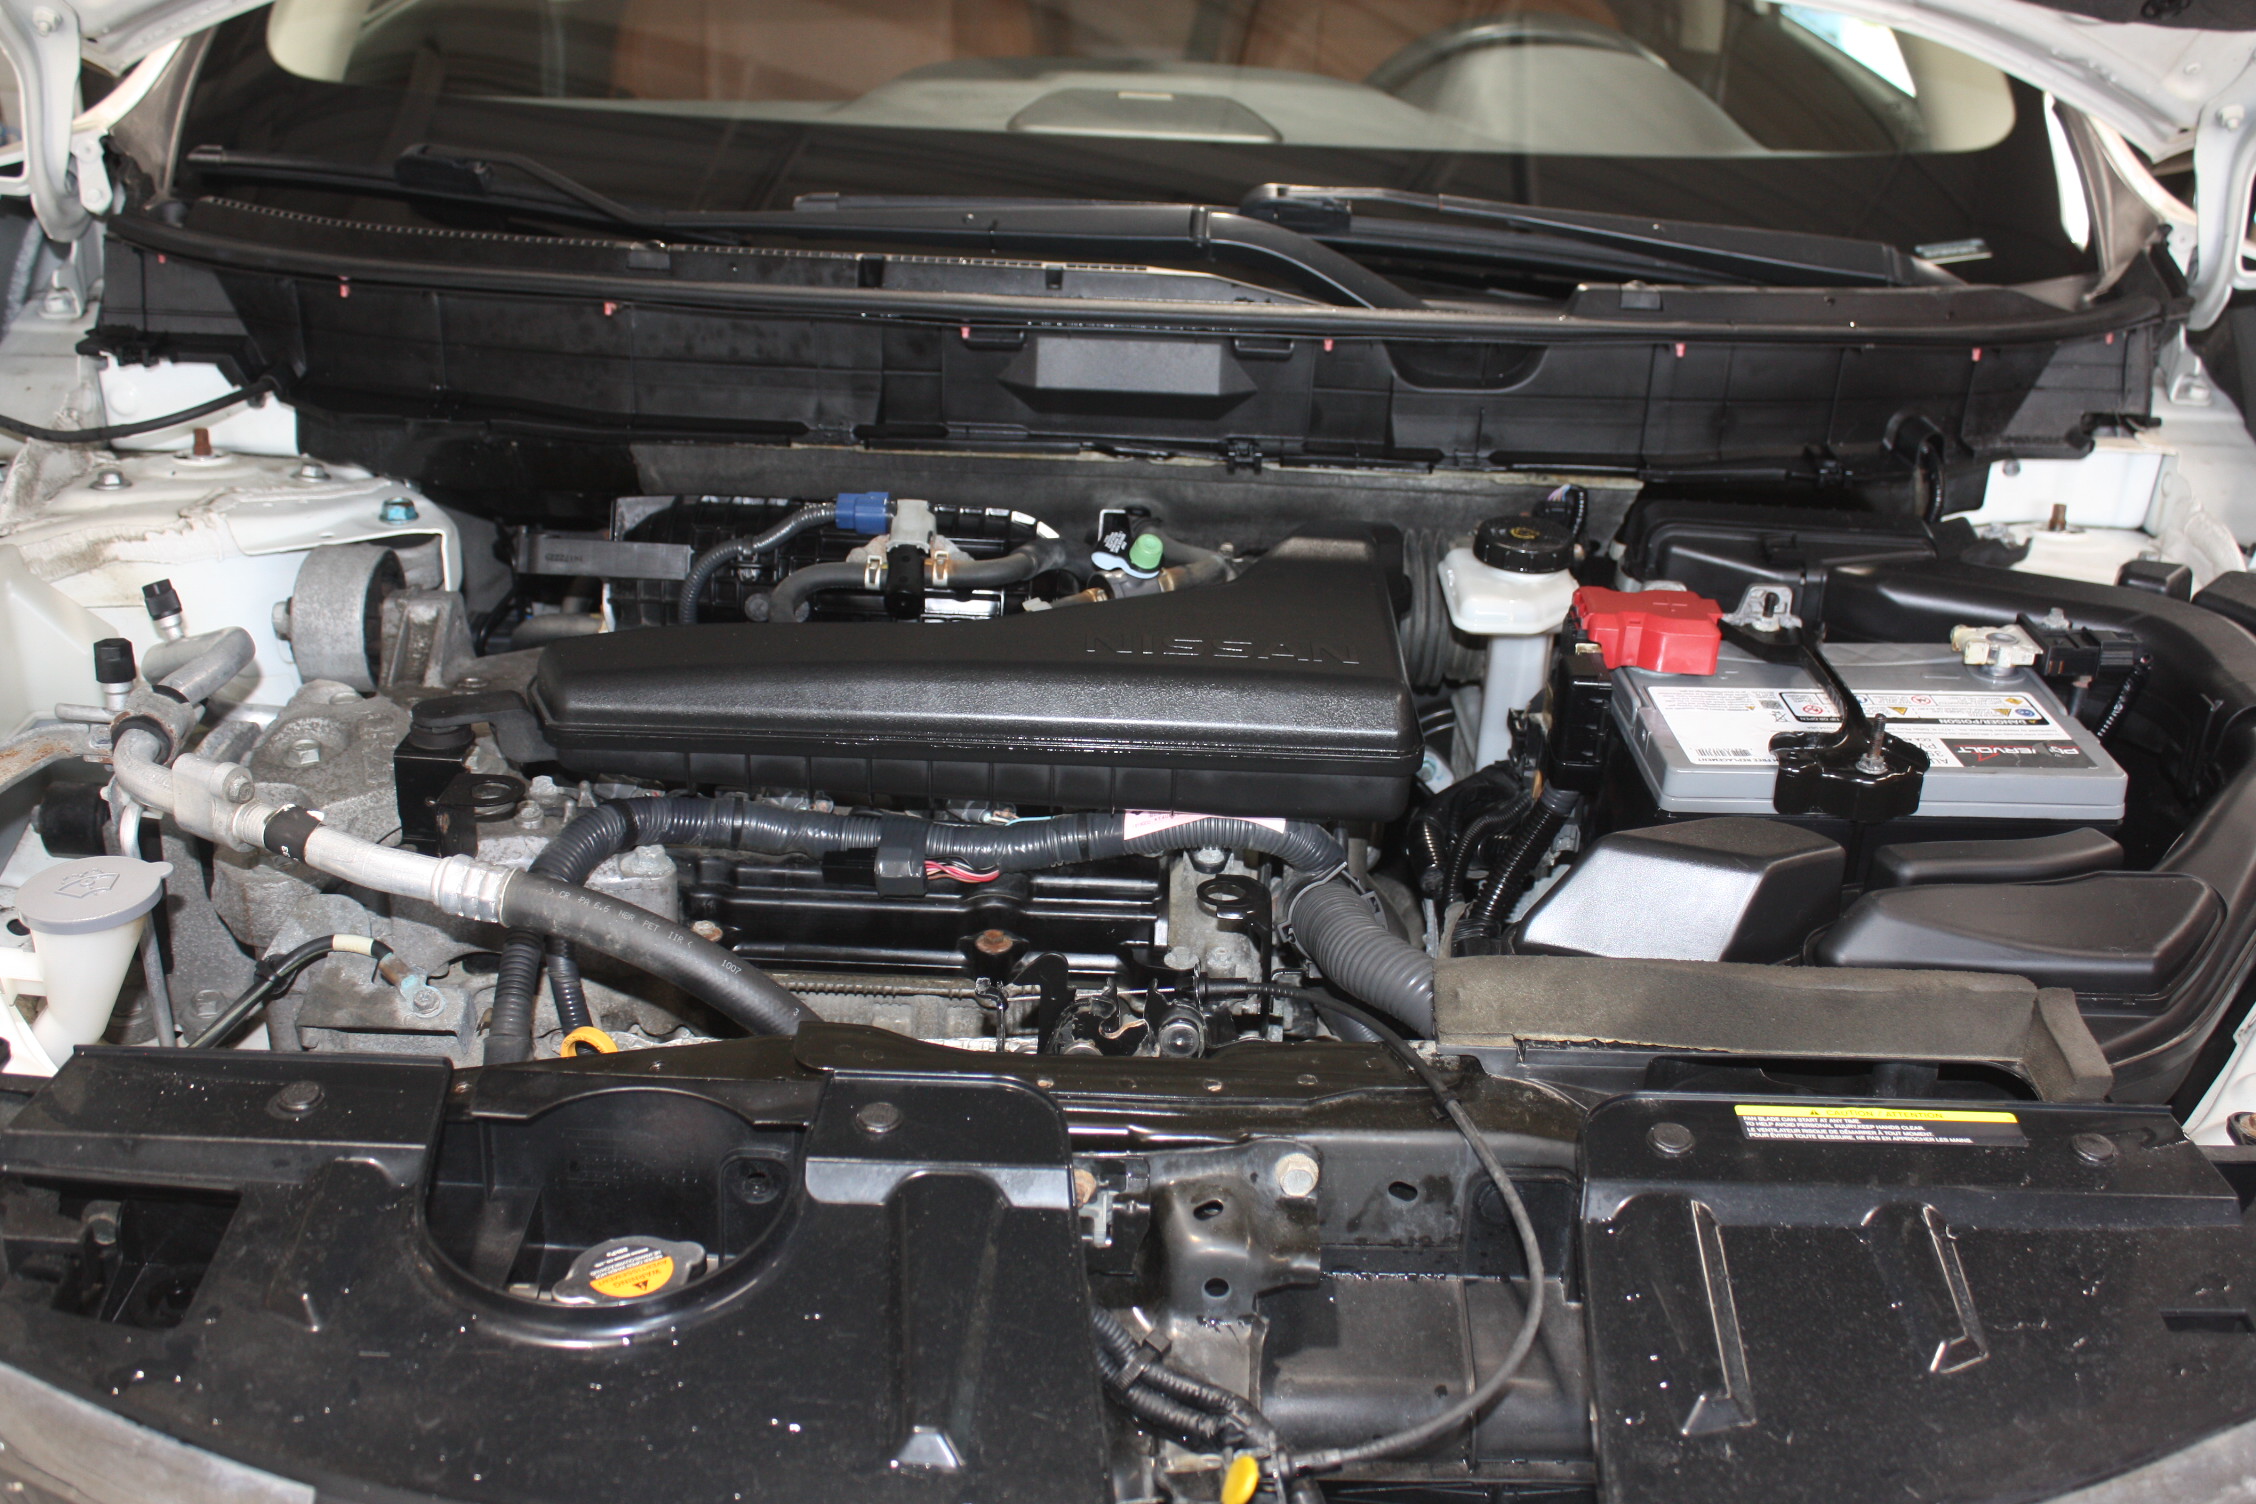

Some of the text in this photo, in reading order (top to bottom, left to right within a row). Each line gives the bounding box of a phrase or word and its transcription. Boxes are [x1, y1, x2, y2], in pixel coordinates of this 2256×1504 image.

[1085, 633, 1360, 664] NISSAN
[559, 890, 571, 900] CR
[578, 896, 589, 907] PA
[594, 902, 611, 913] 6.6
[618, 910, 635, 921] NBR
[643, 920, 660, 933] PET
[721, 960, 742, 975] 1007
[1886, 1111, 1944, 1119] ATTENTION
[613, 1269, 662, 1288] WARNING
